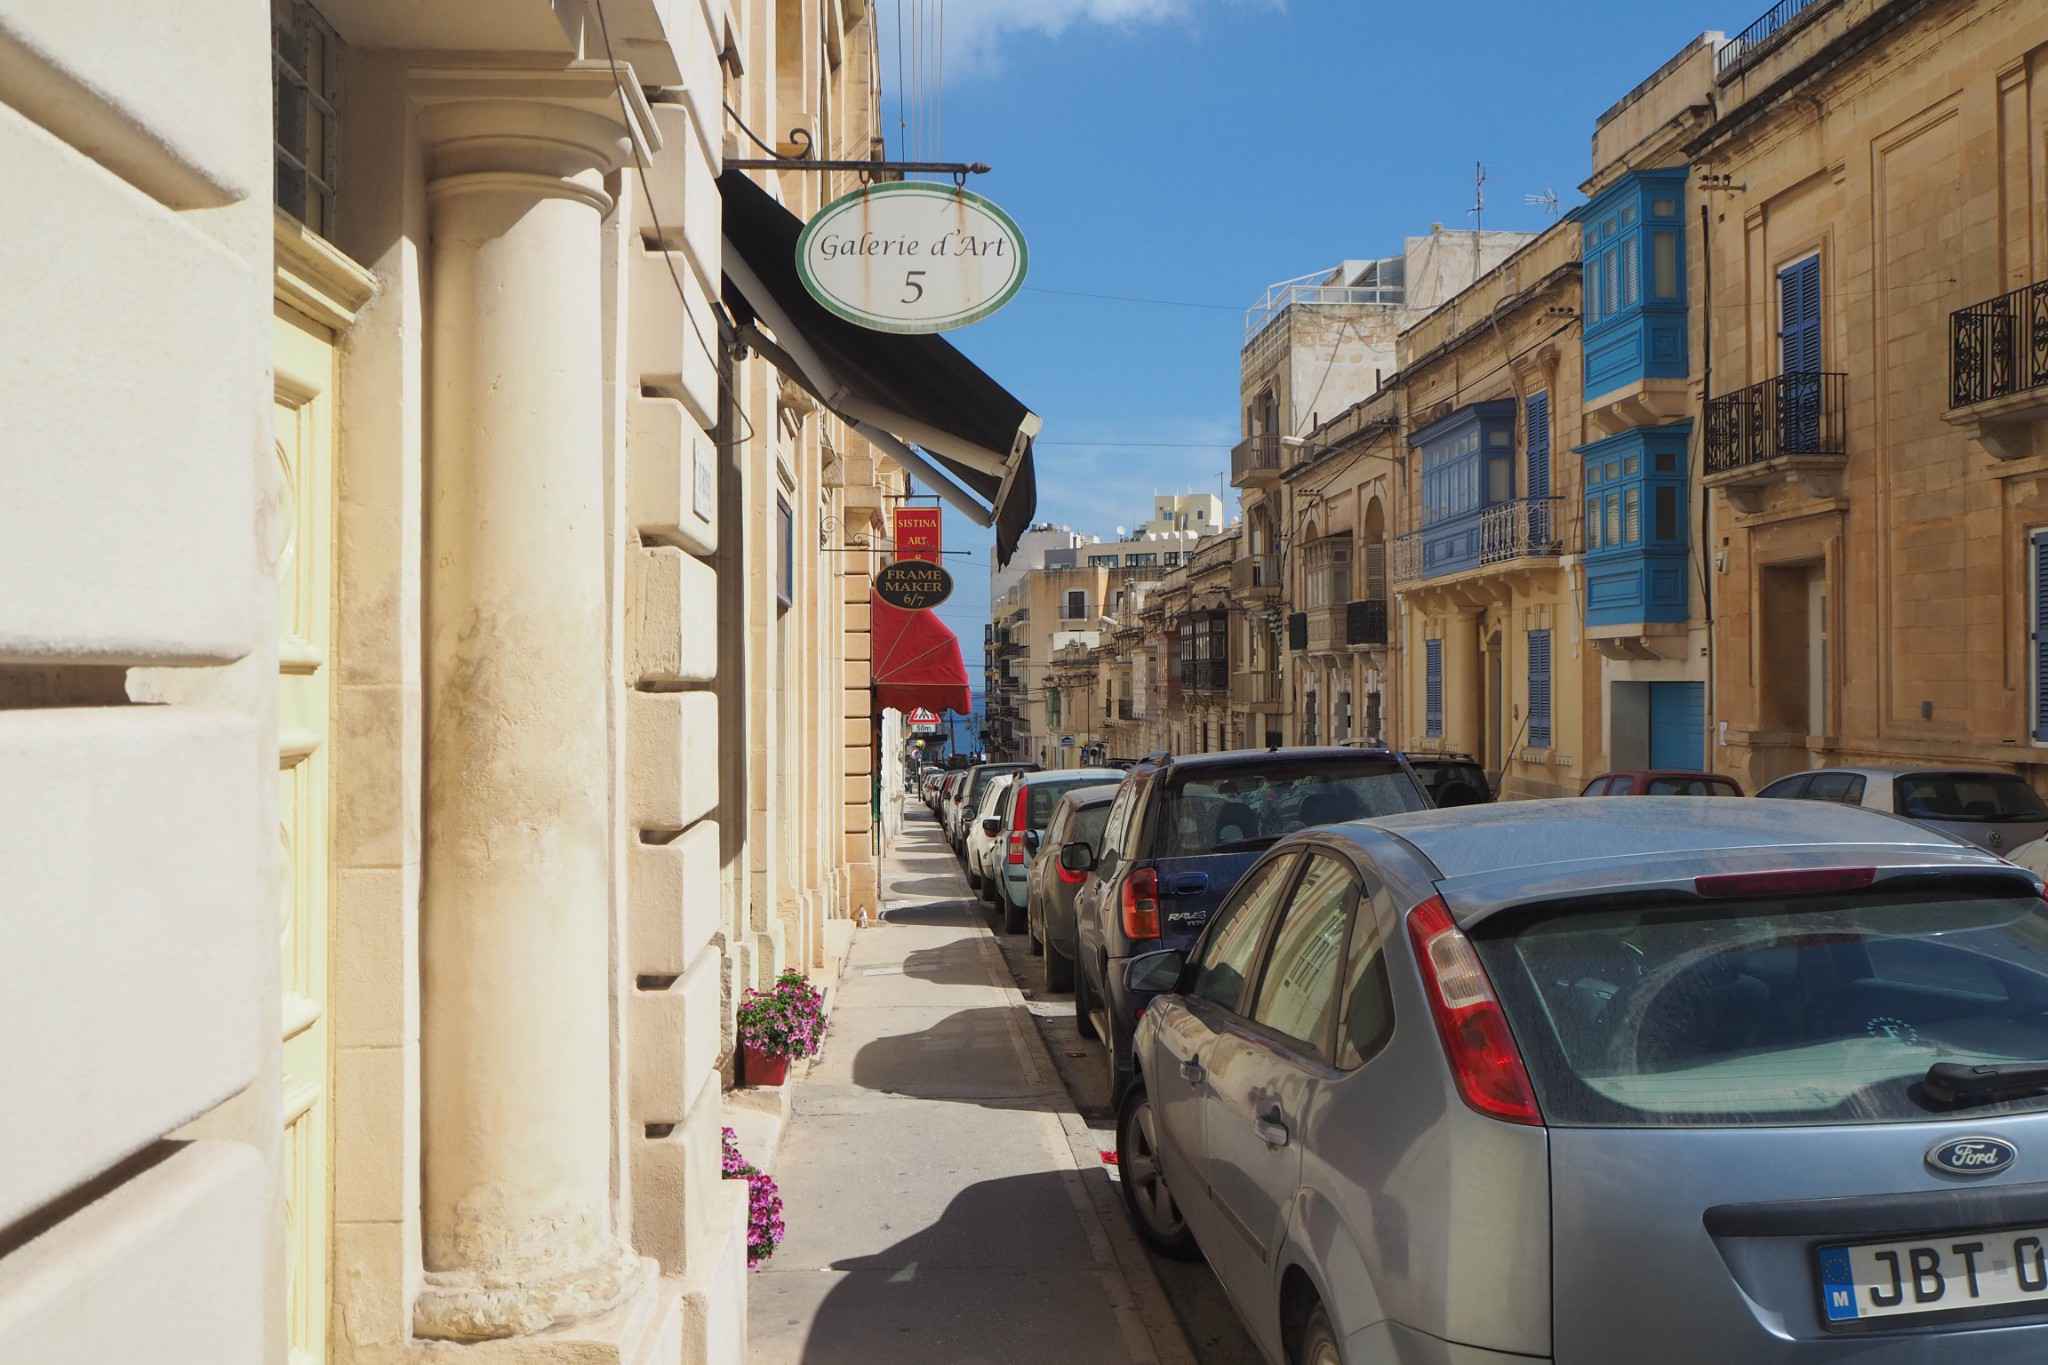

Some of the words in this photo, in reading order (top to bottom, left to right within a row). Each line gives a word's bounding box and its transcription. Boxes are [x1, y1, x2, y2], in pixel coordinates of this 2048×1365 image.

[820, 232, 919, 261] Galerie
[930, 228, 1008, 257] d'Art
[901, 270, 926, 304] 5
[897, 519, 937, 528] SISTINA
[887, 570, 942, 581] FRAME
[885, 582, 942, 592] MAKER
[903, 593, 924, 607] 6/7
[1952, 1144, 1998, 1166] Ford
[1870, 1242, 1984, 1307] JBT
[1832, 1291, 1849, 1307] M
